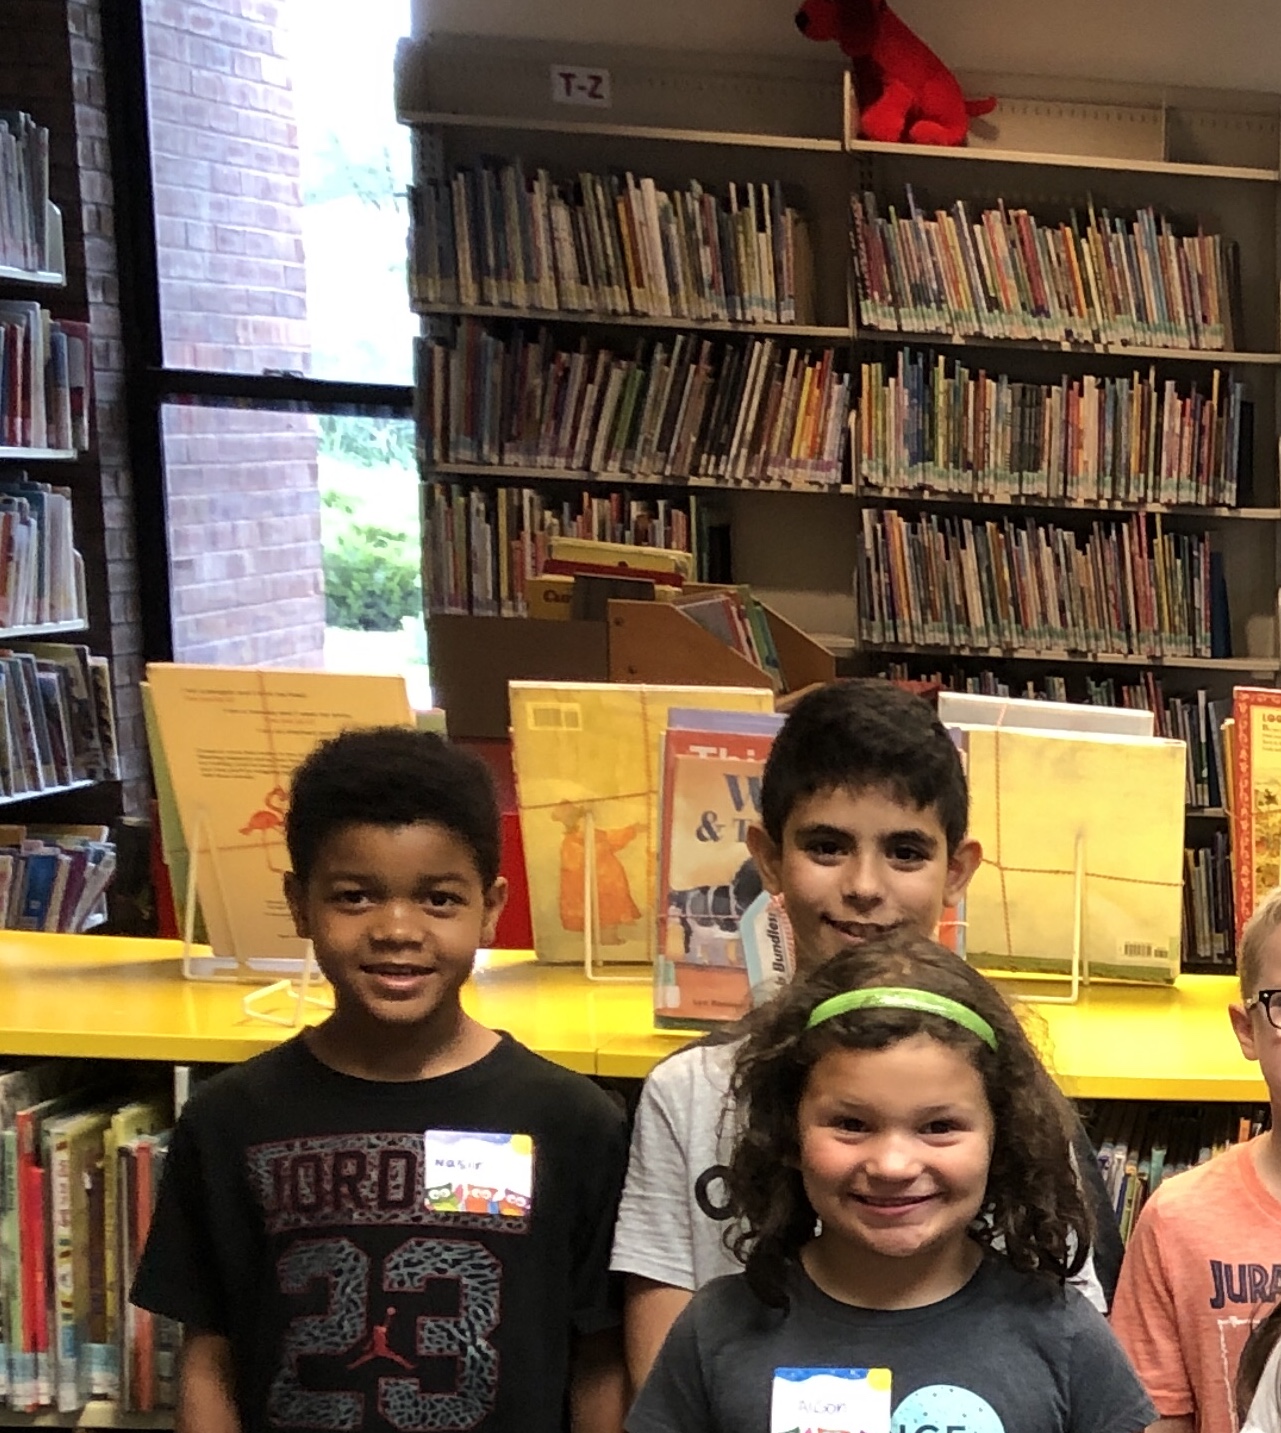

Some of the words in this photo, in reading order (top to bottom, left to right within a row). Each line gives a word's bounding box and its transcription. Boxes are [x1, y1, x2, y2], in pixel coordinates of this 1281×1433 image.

[558, 72, 604, 99] T-Z
[696, 811, 725, 843] &
[270, 1150, 420, 1214] JORD
[268, 1235, 504, 1432] 23
